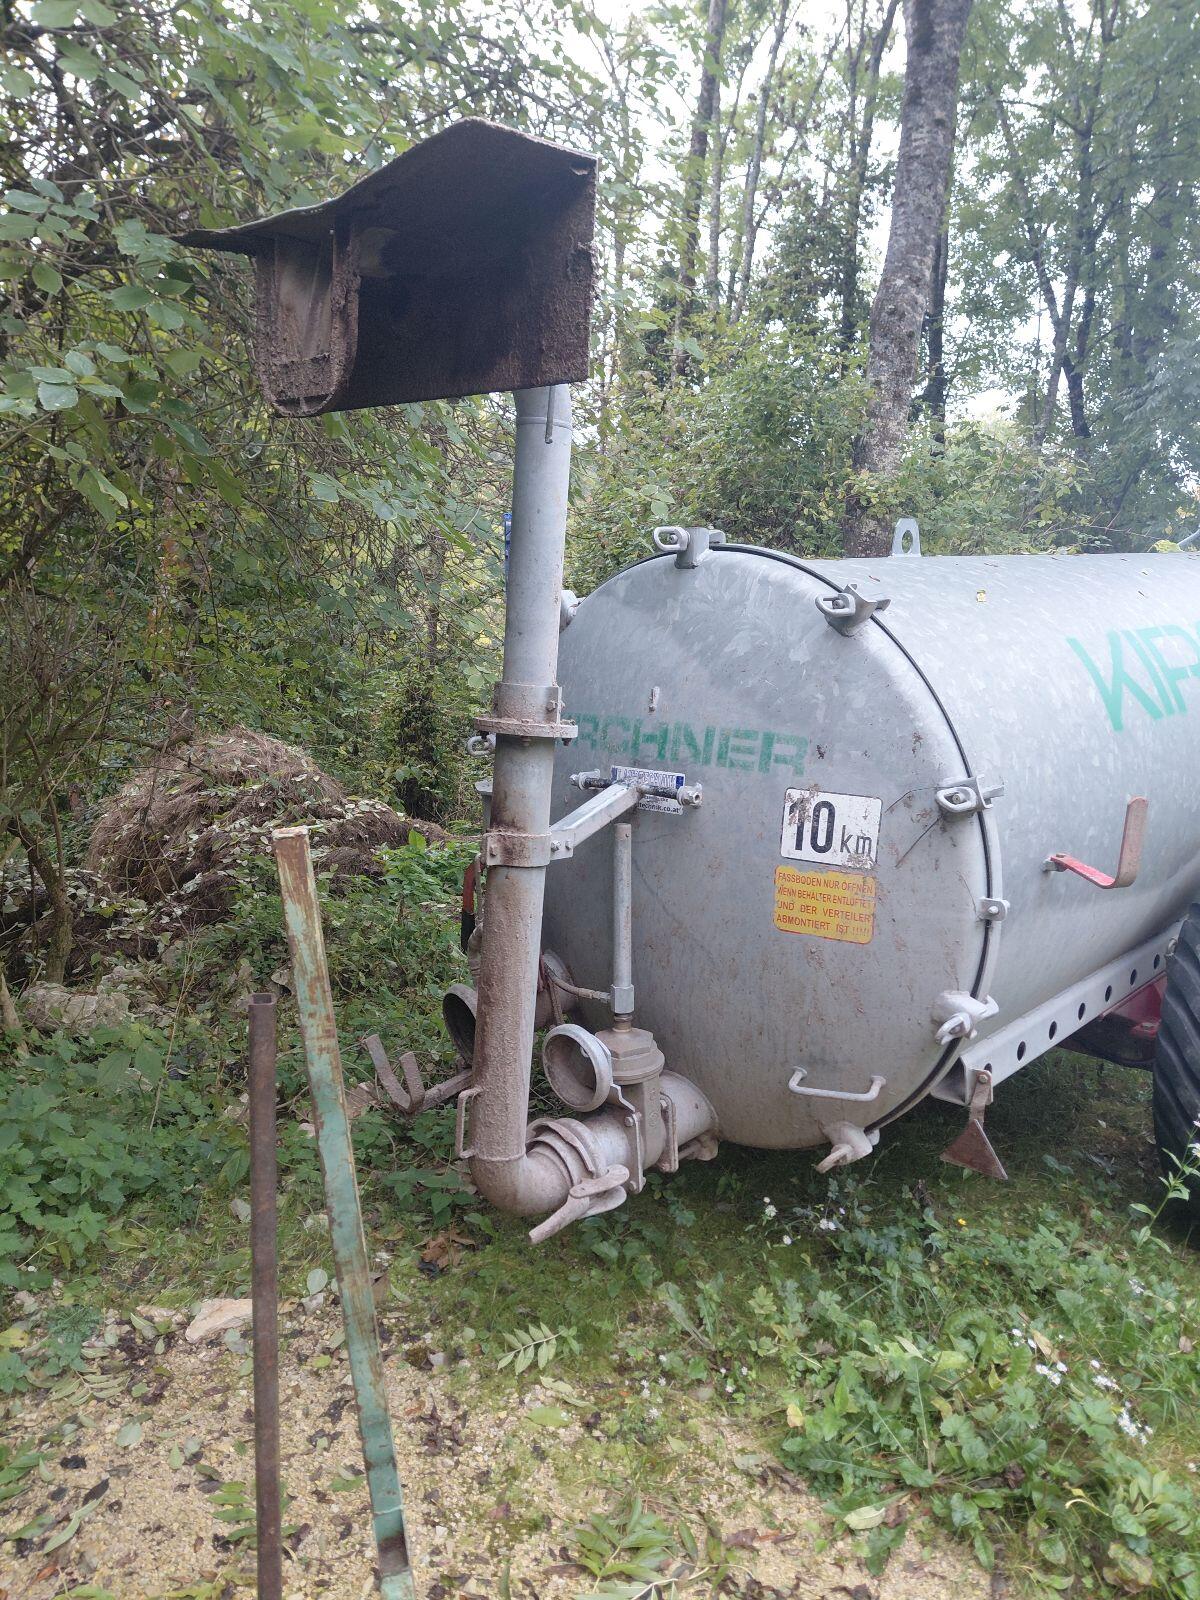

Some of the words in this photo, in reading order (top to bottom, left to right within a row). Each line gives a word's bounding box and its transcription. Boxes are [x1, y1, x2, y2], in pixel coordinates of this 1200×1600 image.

[788, 798, 836, 854] 10
[840, 825, 873, 857] km
[778, 872, 821, 887] FASSBODEN
[823, 880, 840, 890] NUR
[800, 904, 817, 915] DER
[822, 908, 871, 923] VERTEILER
[777, 914, 831, 931] ABMONTIERT
[836, 924, 850, 935] IST
